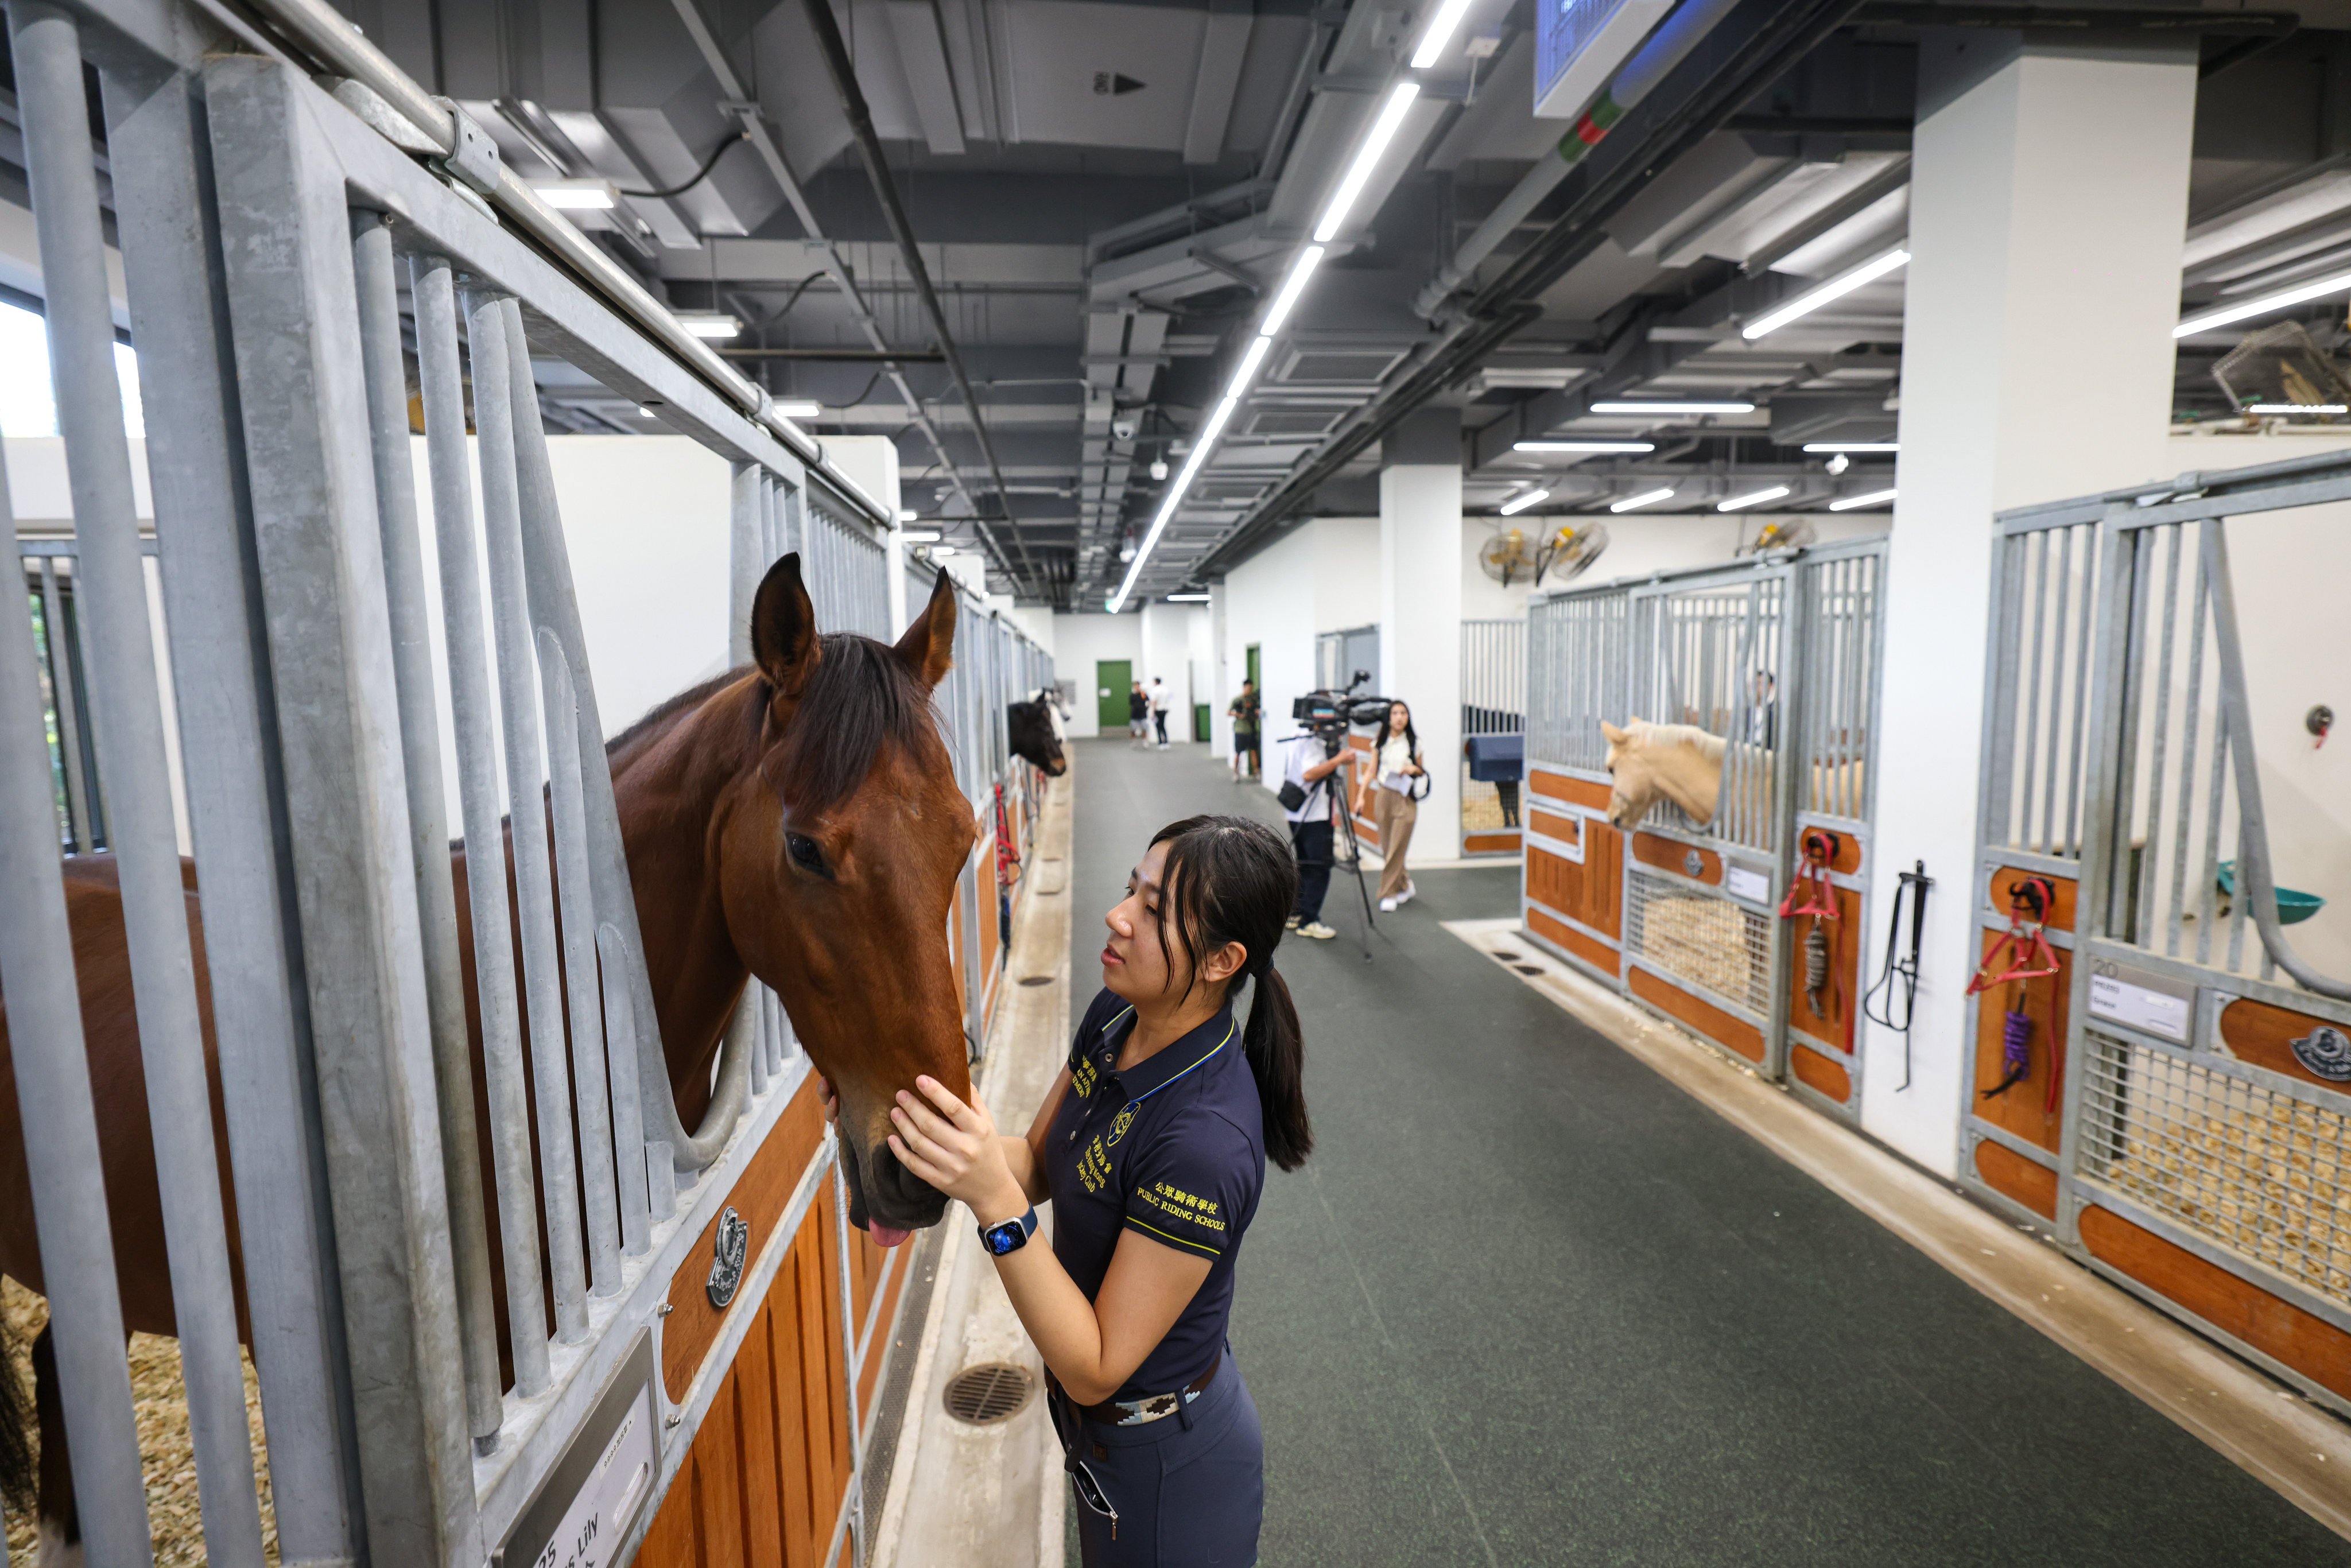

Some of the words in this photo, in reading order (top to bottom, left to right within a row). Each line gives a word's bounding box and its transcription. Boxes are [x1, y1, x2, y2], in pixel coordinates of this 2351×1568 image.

[1084, 1175, 1096, 1192] Club
[1093, 1167, 1105, 1188] Kong
[1137, 1187, 1159, 1206] PUBLIC
[1160, 1200, 1193, 1220] RIDING
[1194, 1214, 1225, 1231] SCHOOLS
[1155, 1181, 1218, 1214] 公眾騎術學校
[577, 1512, 598, 1558] Lily
